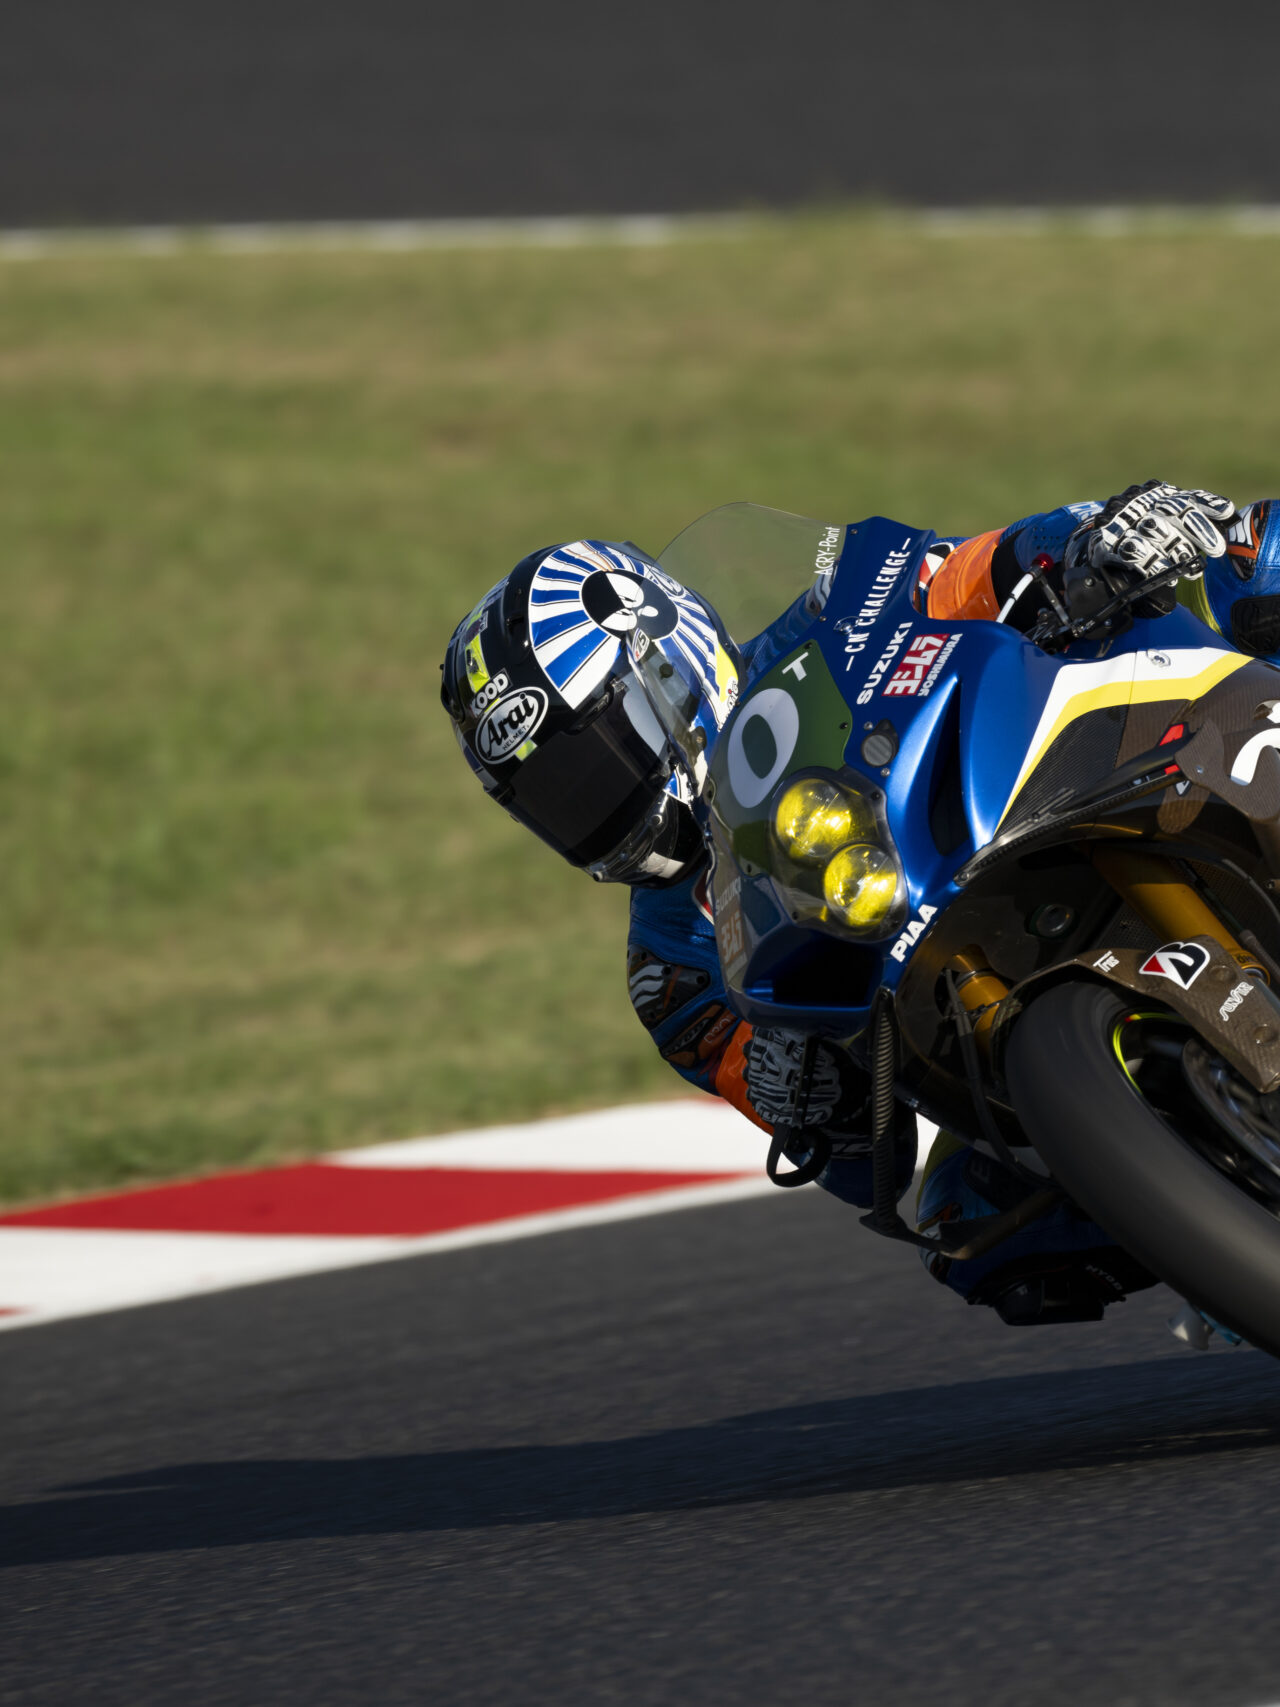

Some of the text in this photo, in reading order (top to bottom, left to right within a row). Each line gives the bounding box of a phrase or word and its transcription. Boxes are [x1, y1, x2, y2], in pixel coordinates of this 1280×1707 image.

[845, 551, 911, 653] CN CHALLENGE
[782, 652, 809, 681] T
[857, 622, 913, 705] SUZUKI
[918, 634, 963, 697] YOSHIMURA
[484, 692, 536, 758] Arai
[502, 726, 527, 751] HELMET
[890, 904, 938, 962] PIAA
